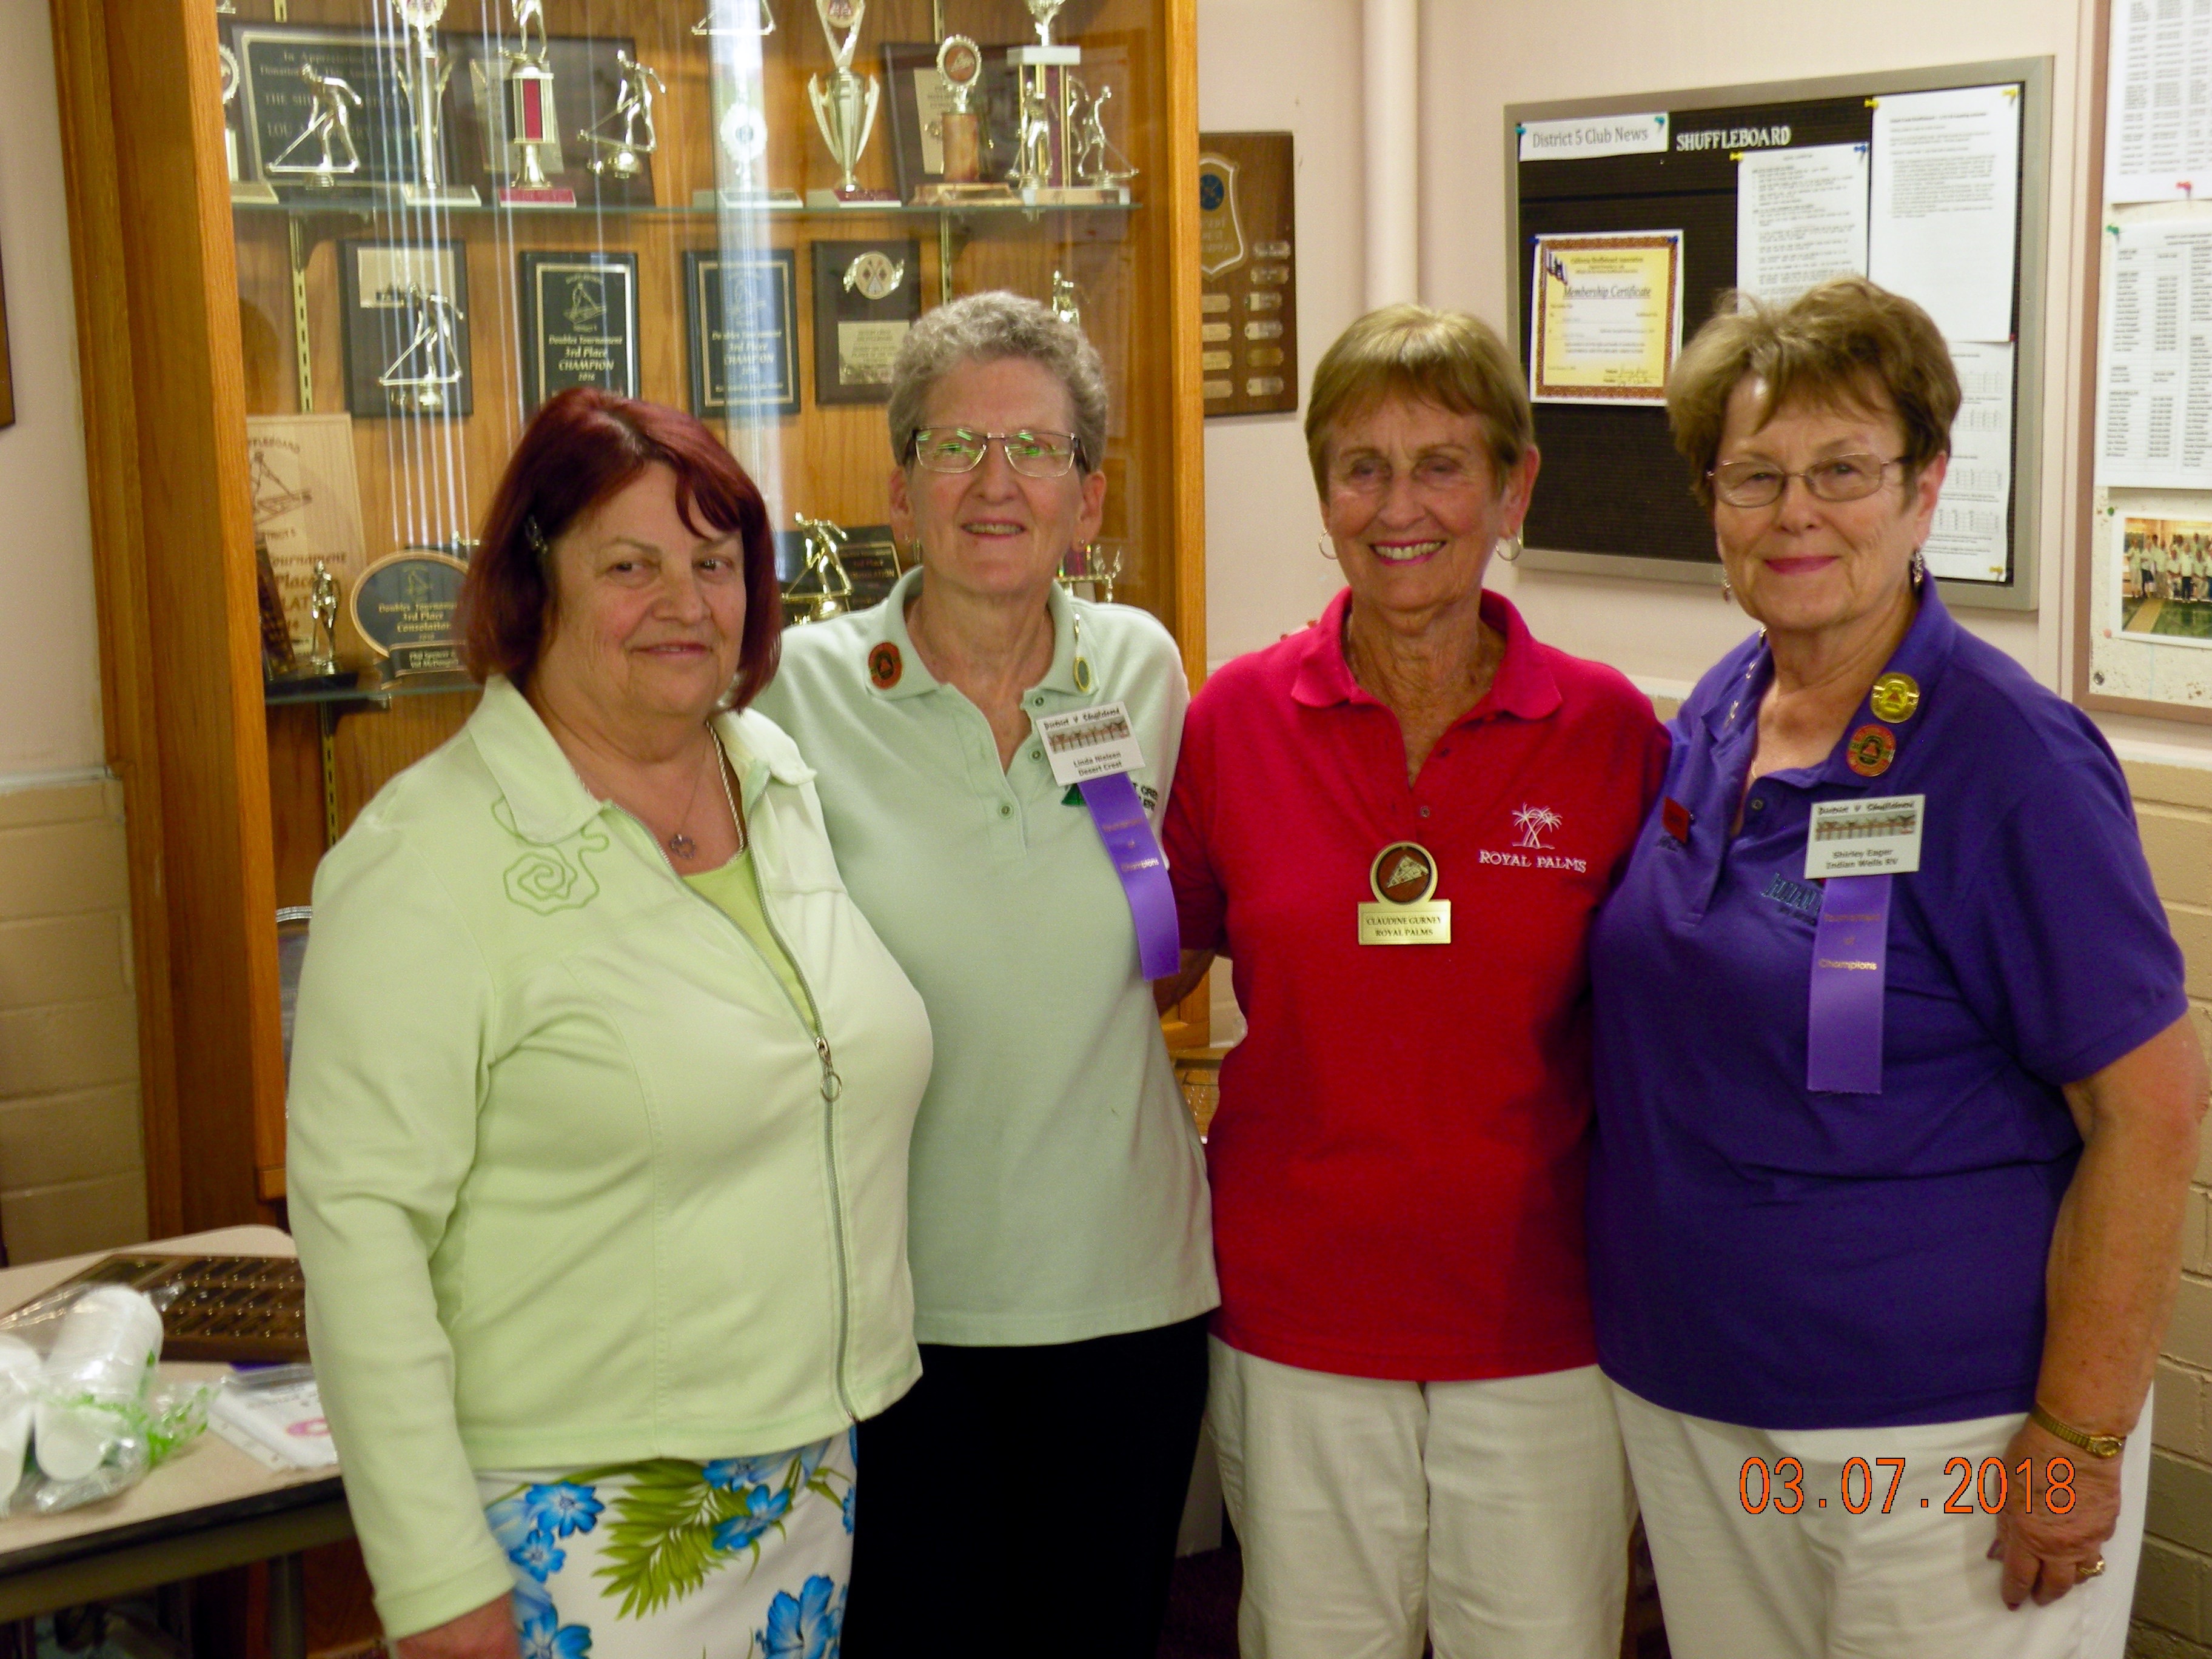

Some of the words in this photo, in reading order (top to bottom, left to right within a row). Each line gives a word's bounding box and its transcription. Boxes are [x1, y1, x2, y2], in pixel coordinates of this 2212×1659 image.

[1533, 131, 1572, 149] District
[1575, 129, 1582, 145] 5
[1584, 127, 1612, 145] Club
[1615, 126, 1649, 143] News
[1676, 125, 1792, 152] SHUFFLEBOARD
[1564, 286, 1609, 300] Membership
[1610, 284, 1651, 299] Certificate
[565, 347, 581, 358] 3rd
[583, 347, 608, 358] Place
[558, 359, 614, 371] CHAMPION
[724, 354, 774, 365] CHAMPON
[1073, 758, 1093, 768] Linda
[1094, 751, 1121, 763] Nielsen
[1078, 766, 1102, 777] Desert
[1103, 761, 1122, 771] Crest
[1479, 849, 1532, 867] ROYAL
[1536, 856, 1587, 873] PALMS
[1832, 850, 1863, 859] Shirley
[1826, 860, 1855, 870] Indian
[1858, 859, 1882, 868] Wells
[1885, 857, 1899, 866] RV
[1367, 917, 1407, 925] CLAUDINE
[1409, 916, 1442, 925] GURNEY
[1820, 958, 1877, 971] Champions
